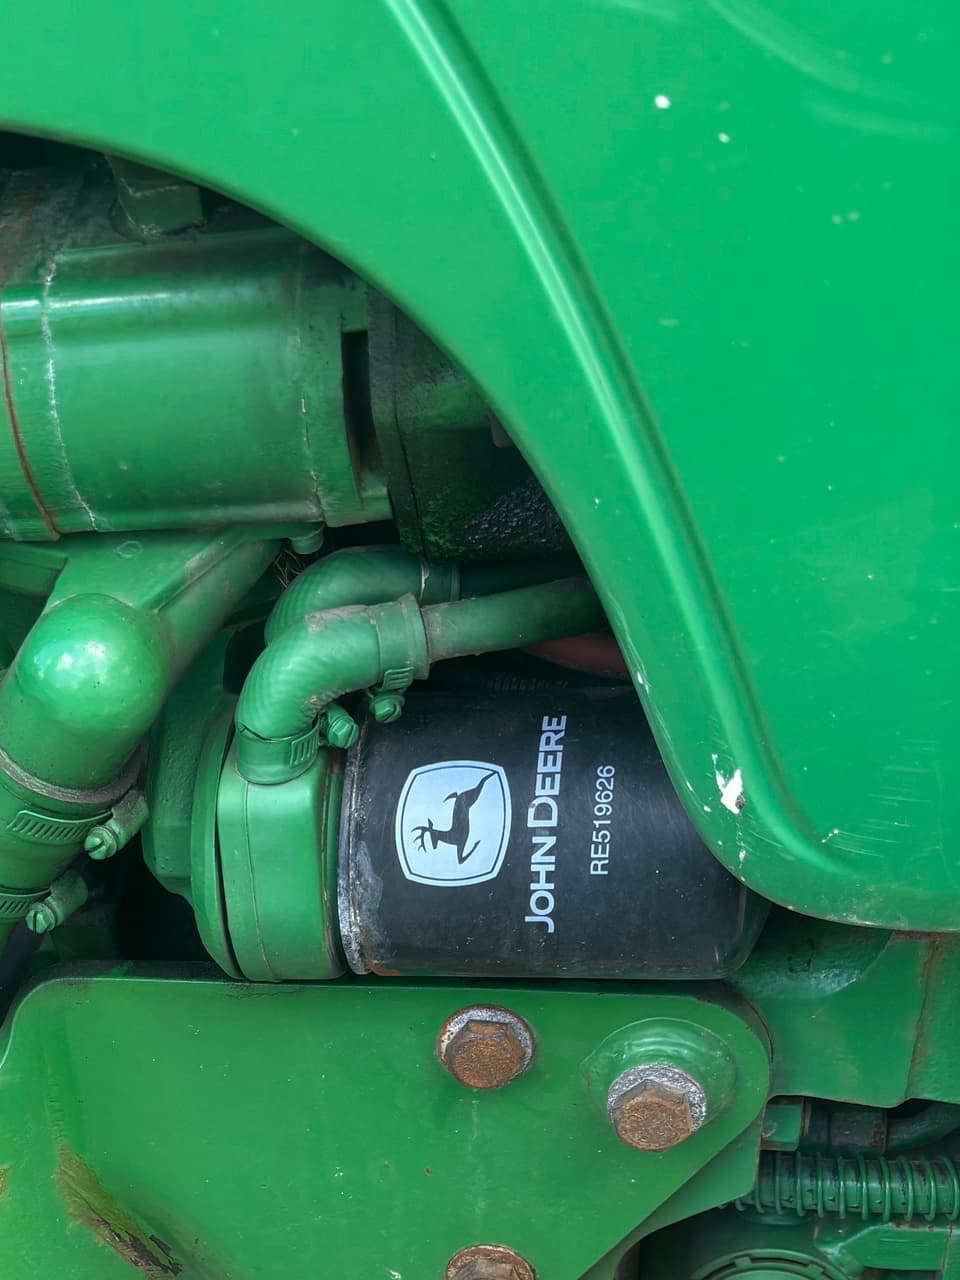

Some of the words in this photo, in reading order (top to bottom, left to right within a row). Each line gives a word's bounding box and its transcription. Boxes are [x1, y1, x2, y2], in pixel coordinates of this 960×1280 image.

[526, 714, 568, 829] DEERE
[590, 764, 616, 876] RE519626
[524, 835, 557, 934] JOHN
